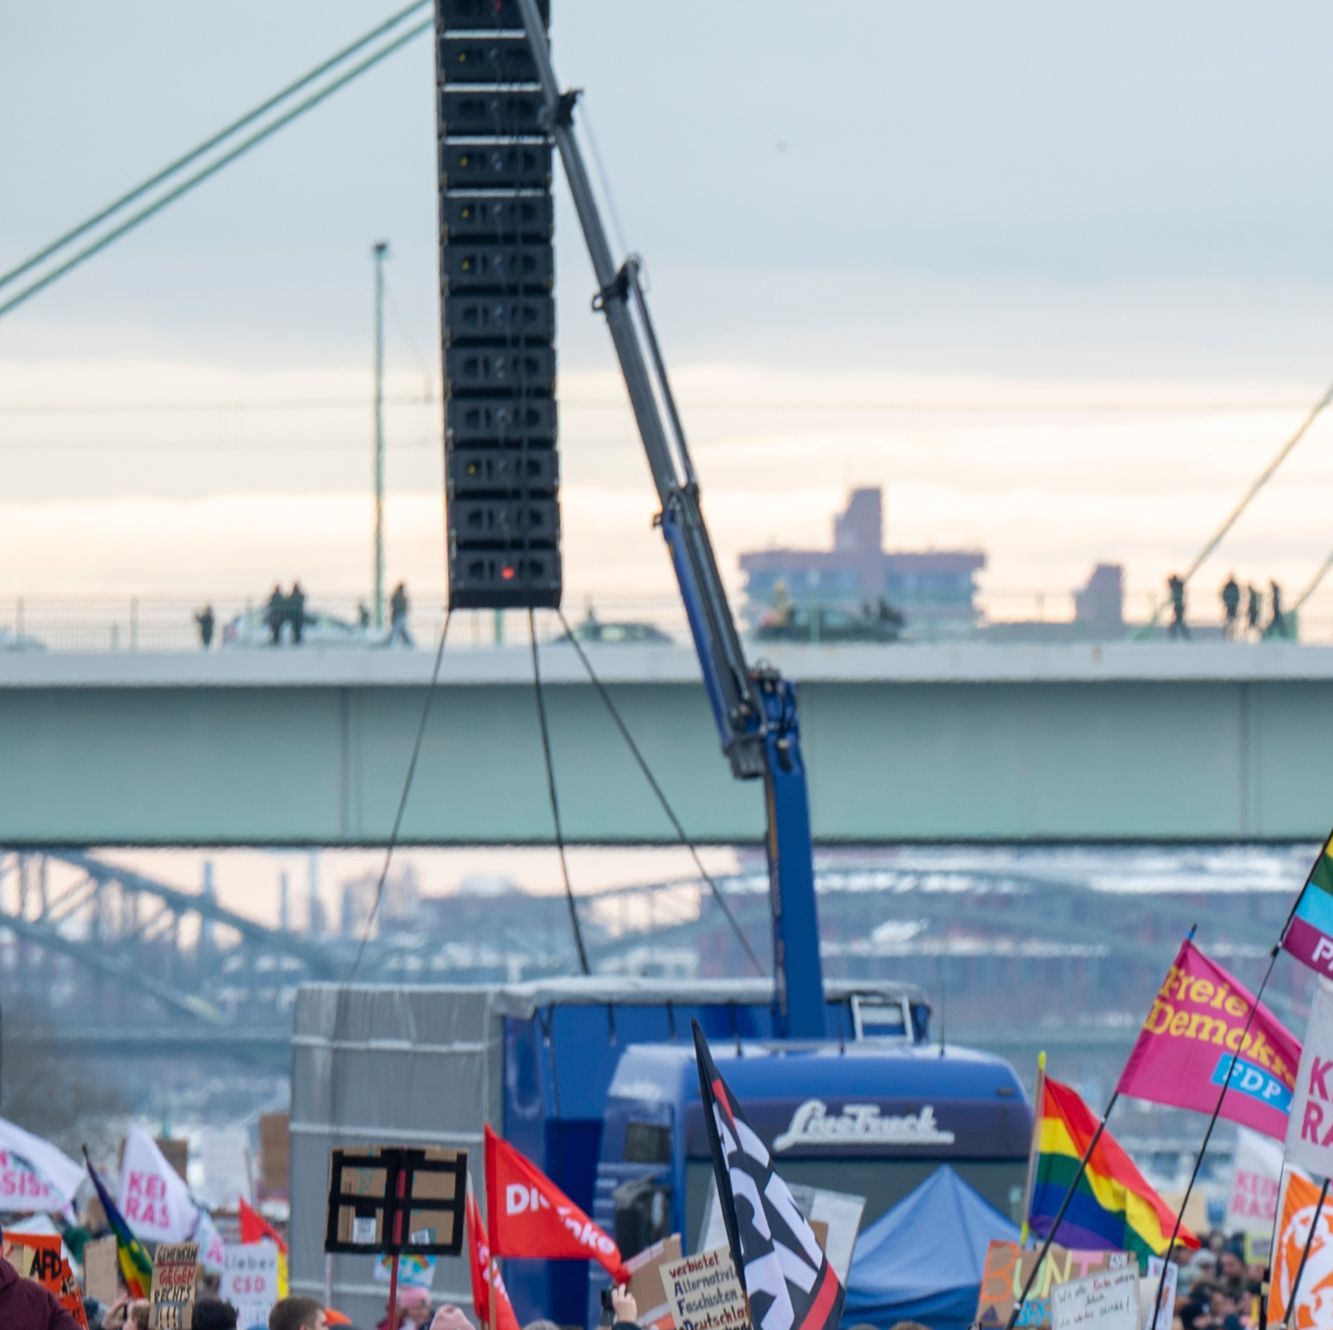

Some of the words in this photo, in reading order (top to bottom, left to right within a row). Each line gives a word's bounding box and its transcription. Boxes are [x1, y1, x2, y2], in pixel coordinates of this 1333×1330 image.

[1158, 965, 1249, 1018] Freie
[1144, 999, 1297, 1088] Demokr
[1221, 1060, 1283, 1100] FDP
[153, 1285, 193, 1304] RECHTS
[159, 1268, 196, 1287] GEGEN
[677, 1288, 739, 1316] Faschisten
